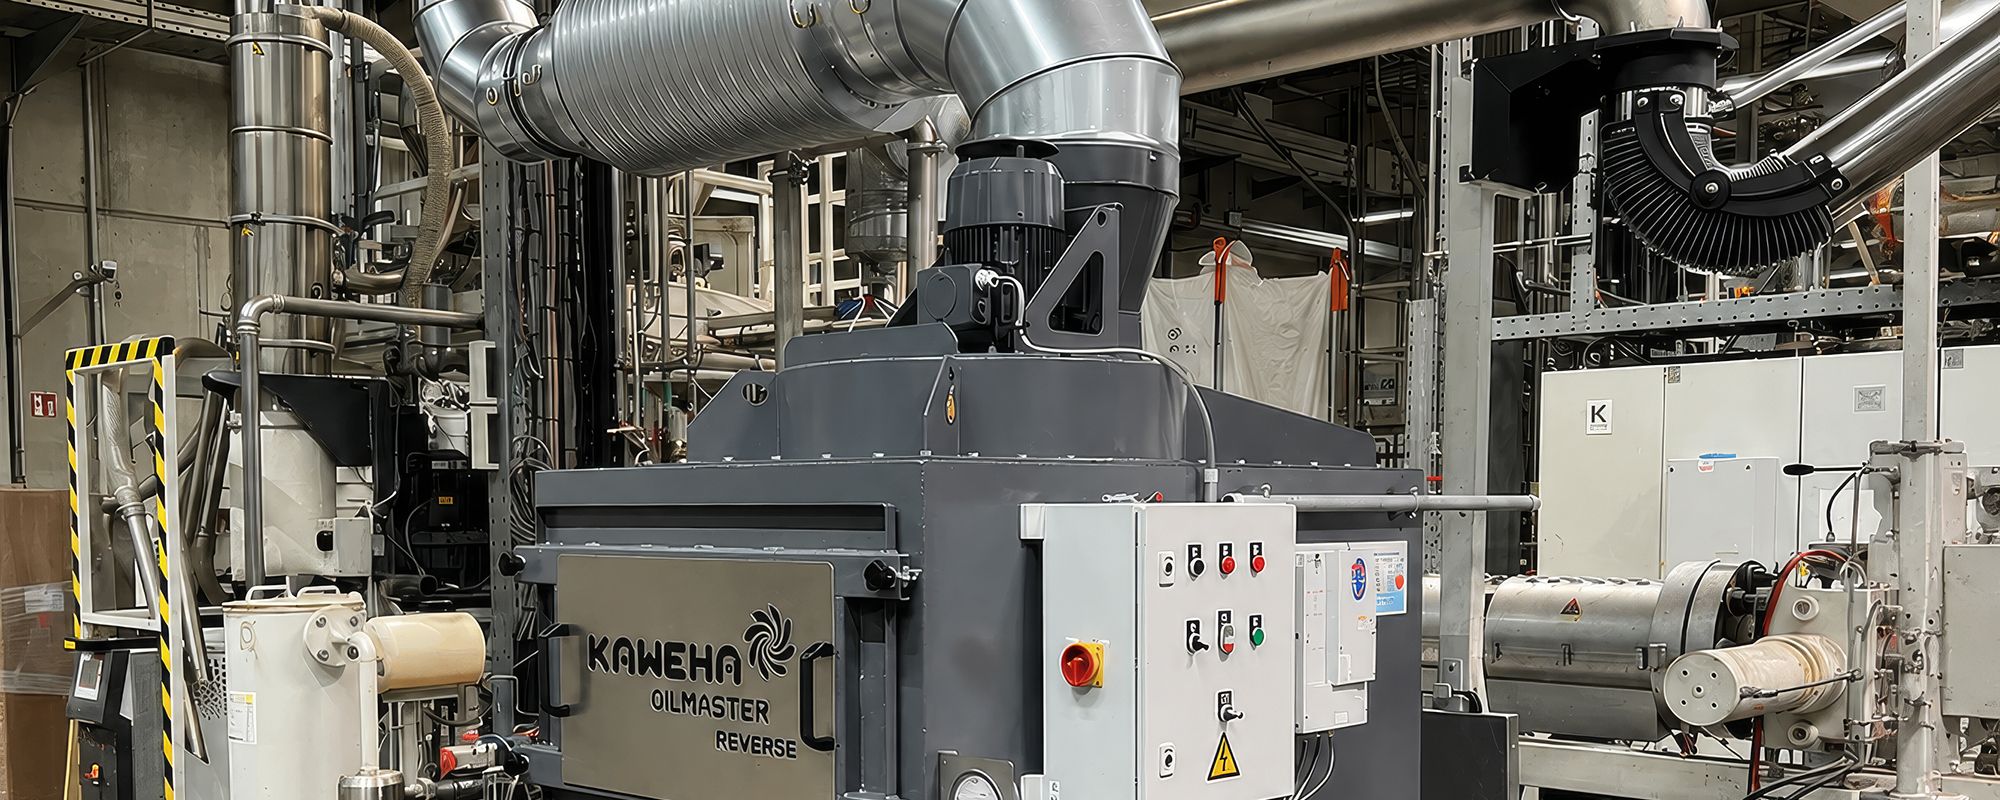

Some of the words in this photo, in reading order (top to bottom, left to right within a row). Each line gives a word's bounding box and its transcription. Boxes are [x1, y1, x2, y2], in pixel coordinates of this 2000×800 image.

[1591, 404, 1607, 423] K
[587, 633, 742, 686] KAWEHA
[651, 689, 770, 725] OILMASTER
[715, 730, 797, 759] REVERSE
